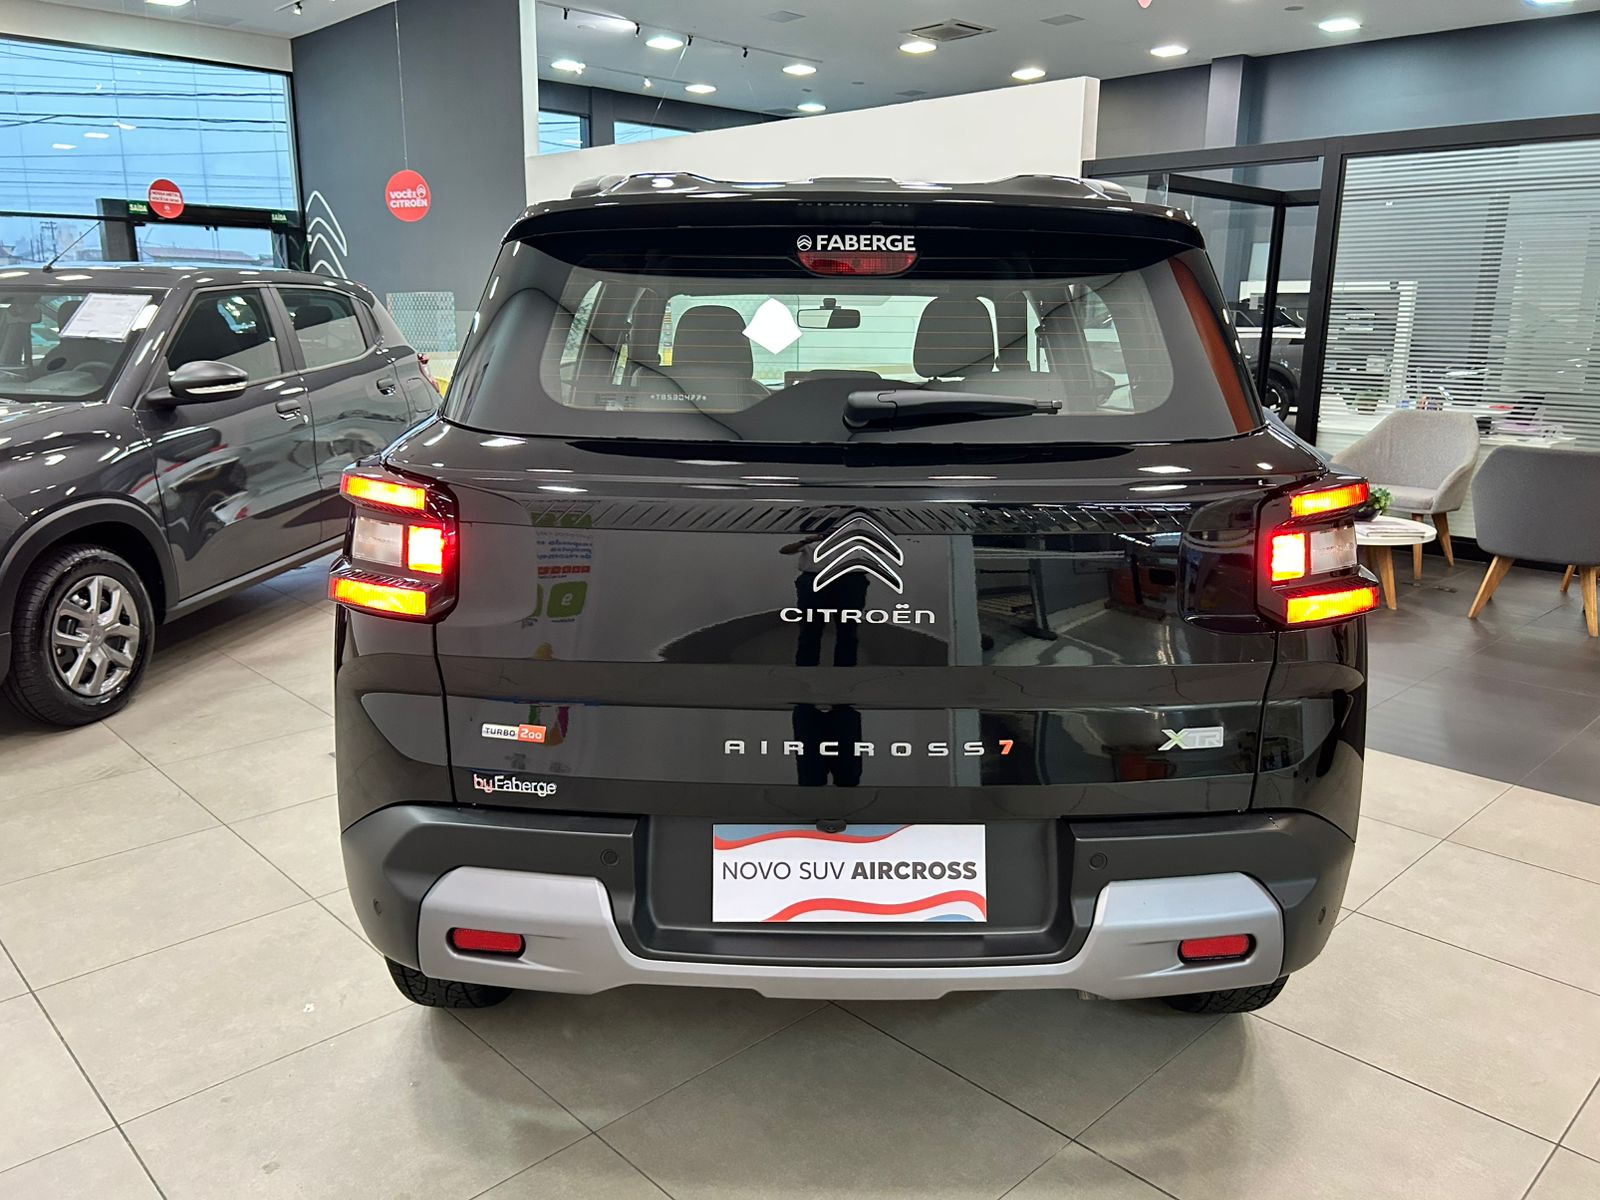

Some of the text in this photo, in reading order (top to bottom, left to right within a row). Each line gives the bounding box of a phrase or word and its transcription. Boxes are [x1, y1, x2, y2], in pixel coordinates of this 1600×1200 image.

[390, 198, 428, 208] CITROËN
[816, 234, 916, 251] FABERGE
[779, 603, 935, 624] CITROËN
[485, 727, 542, 739] TURBO 200
[1158, 727, 1224, 751] XTR
[724, 739, 985, 757] AIRCROSS
[722, 861, 977, 880] NOVO SUV AIRCROSS
